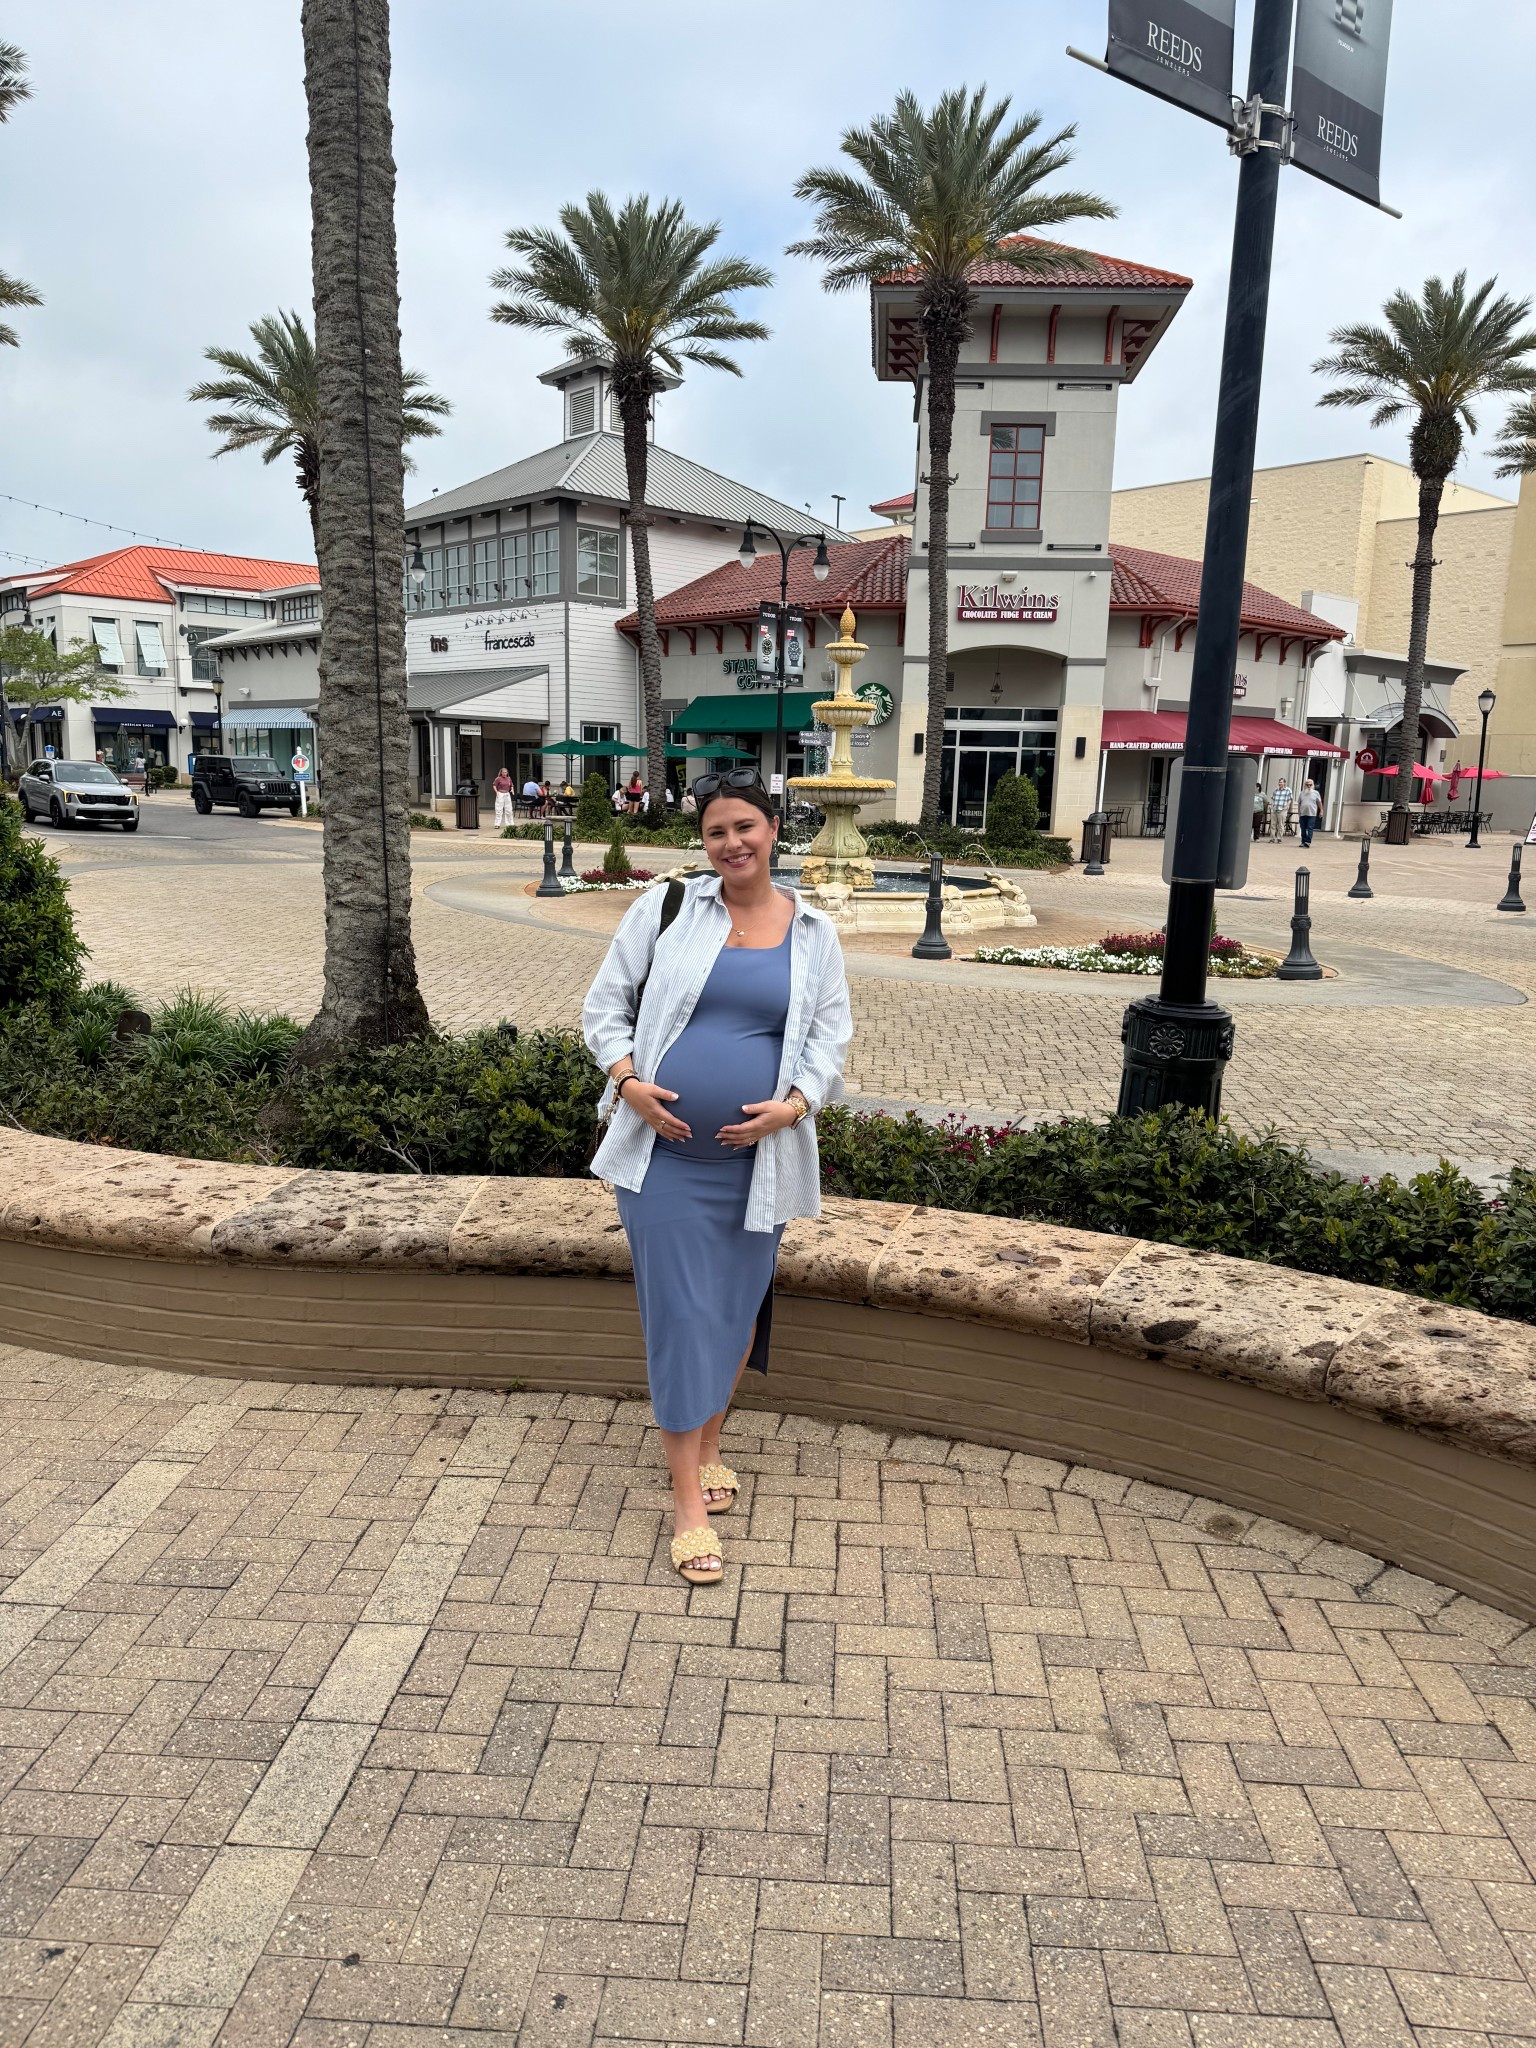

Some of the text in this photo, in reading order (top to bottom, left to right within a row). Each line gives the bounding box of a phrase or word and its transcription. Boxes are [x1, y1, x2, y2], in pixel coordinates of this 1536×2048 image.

[1146, 20, 1202, 72] REEDS
[1156, 55, 1190, 77] JEWELERS
[1316, 114, 1358, 157] REEDS
[957, 584, 1060, 609] Kilwins
[962, 610, 1053, 619] CHOCOLATES FUDGE ICE CREAM
[484, 630, 535, 651] francesca's
[1109, 741, 1184, 750] HAND-CRAFTED CHOCOLATES
